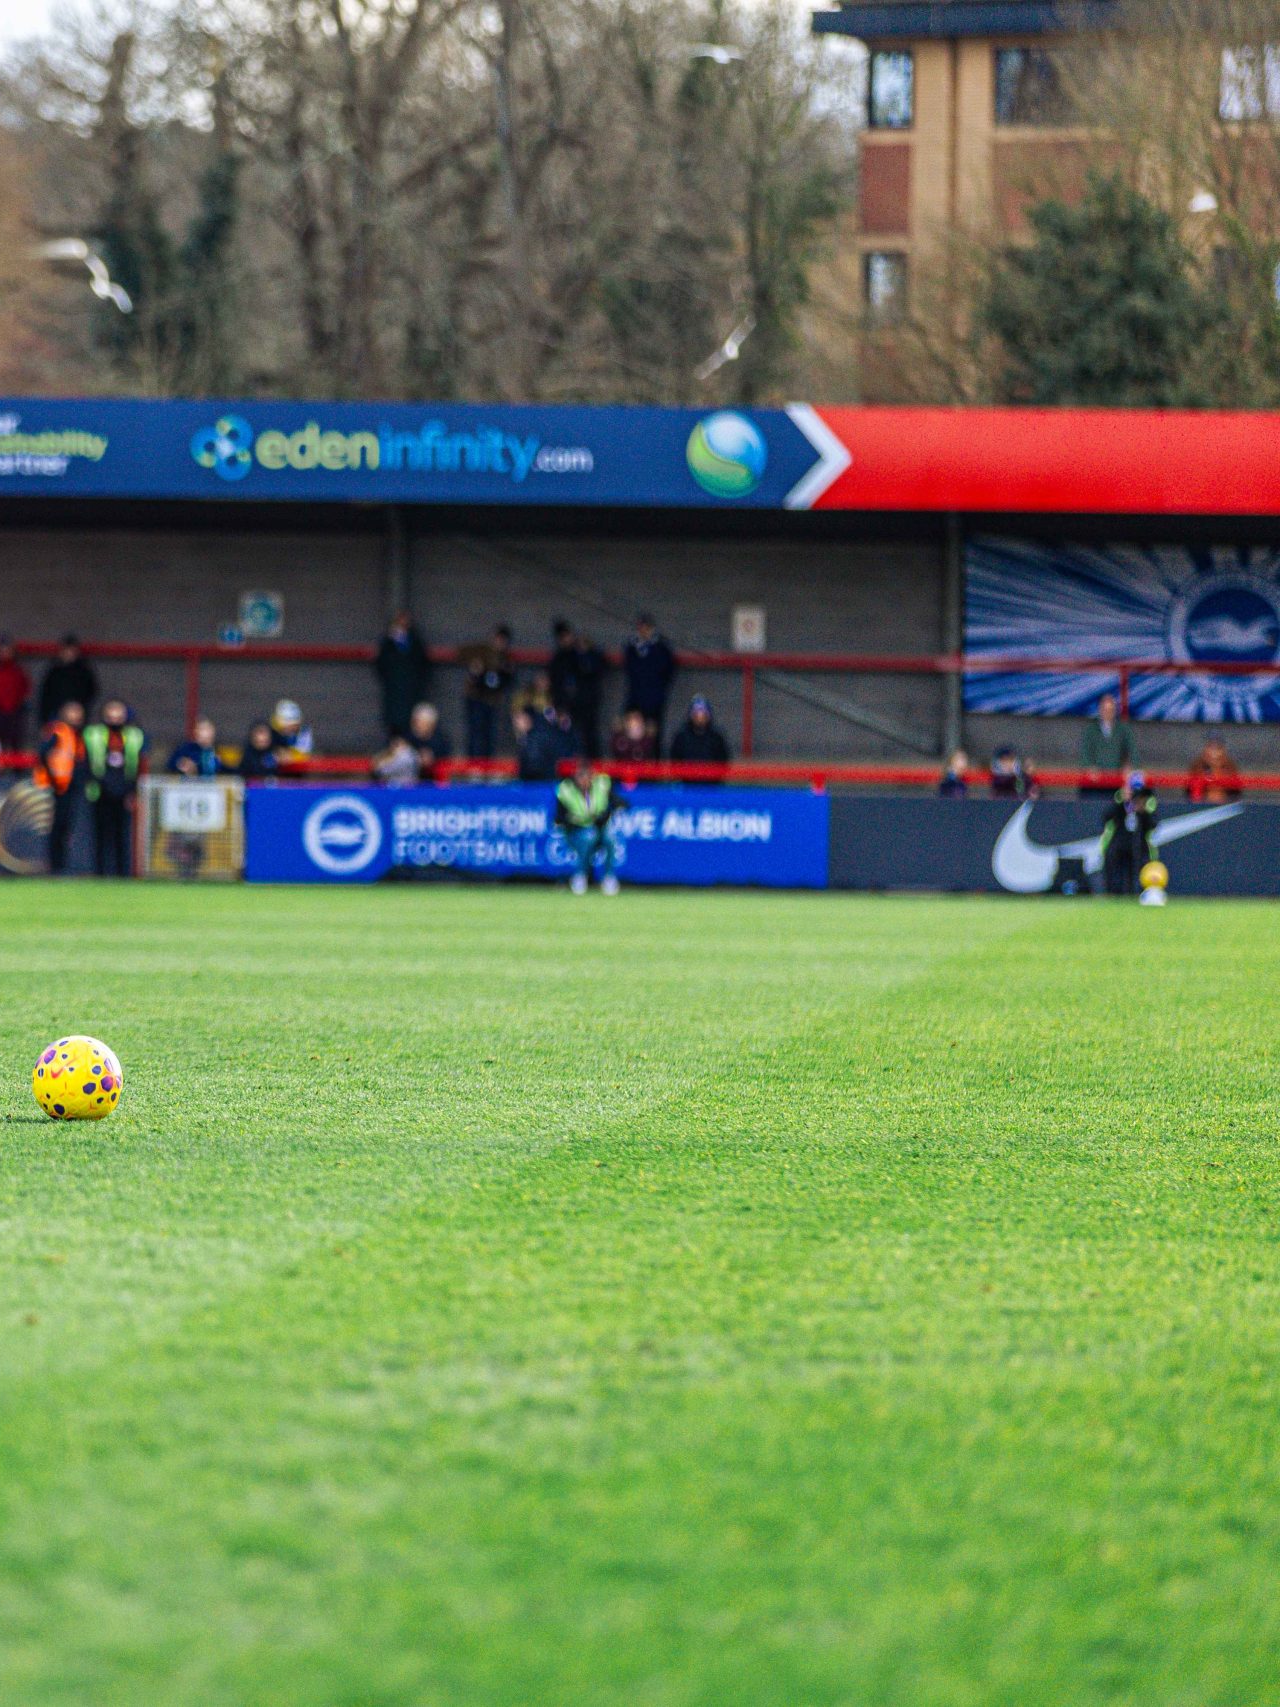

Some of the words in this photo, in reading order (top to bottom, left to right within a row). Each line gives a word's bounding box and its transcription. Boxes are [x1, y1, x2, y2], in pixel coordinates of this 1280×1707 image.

[393, 805, 548, 838] BRIGHTON
[661, 808, 772, 842] ALBION
[394, 839, 538, 867] FOOTBALL
